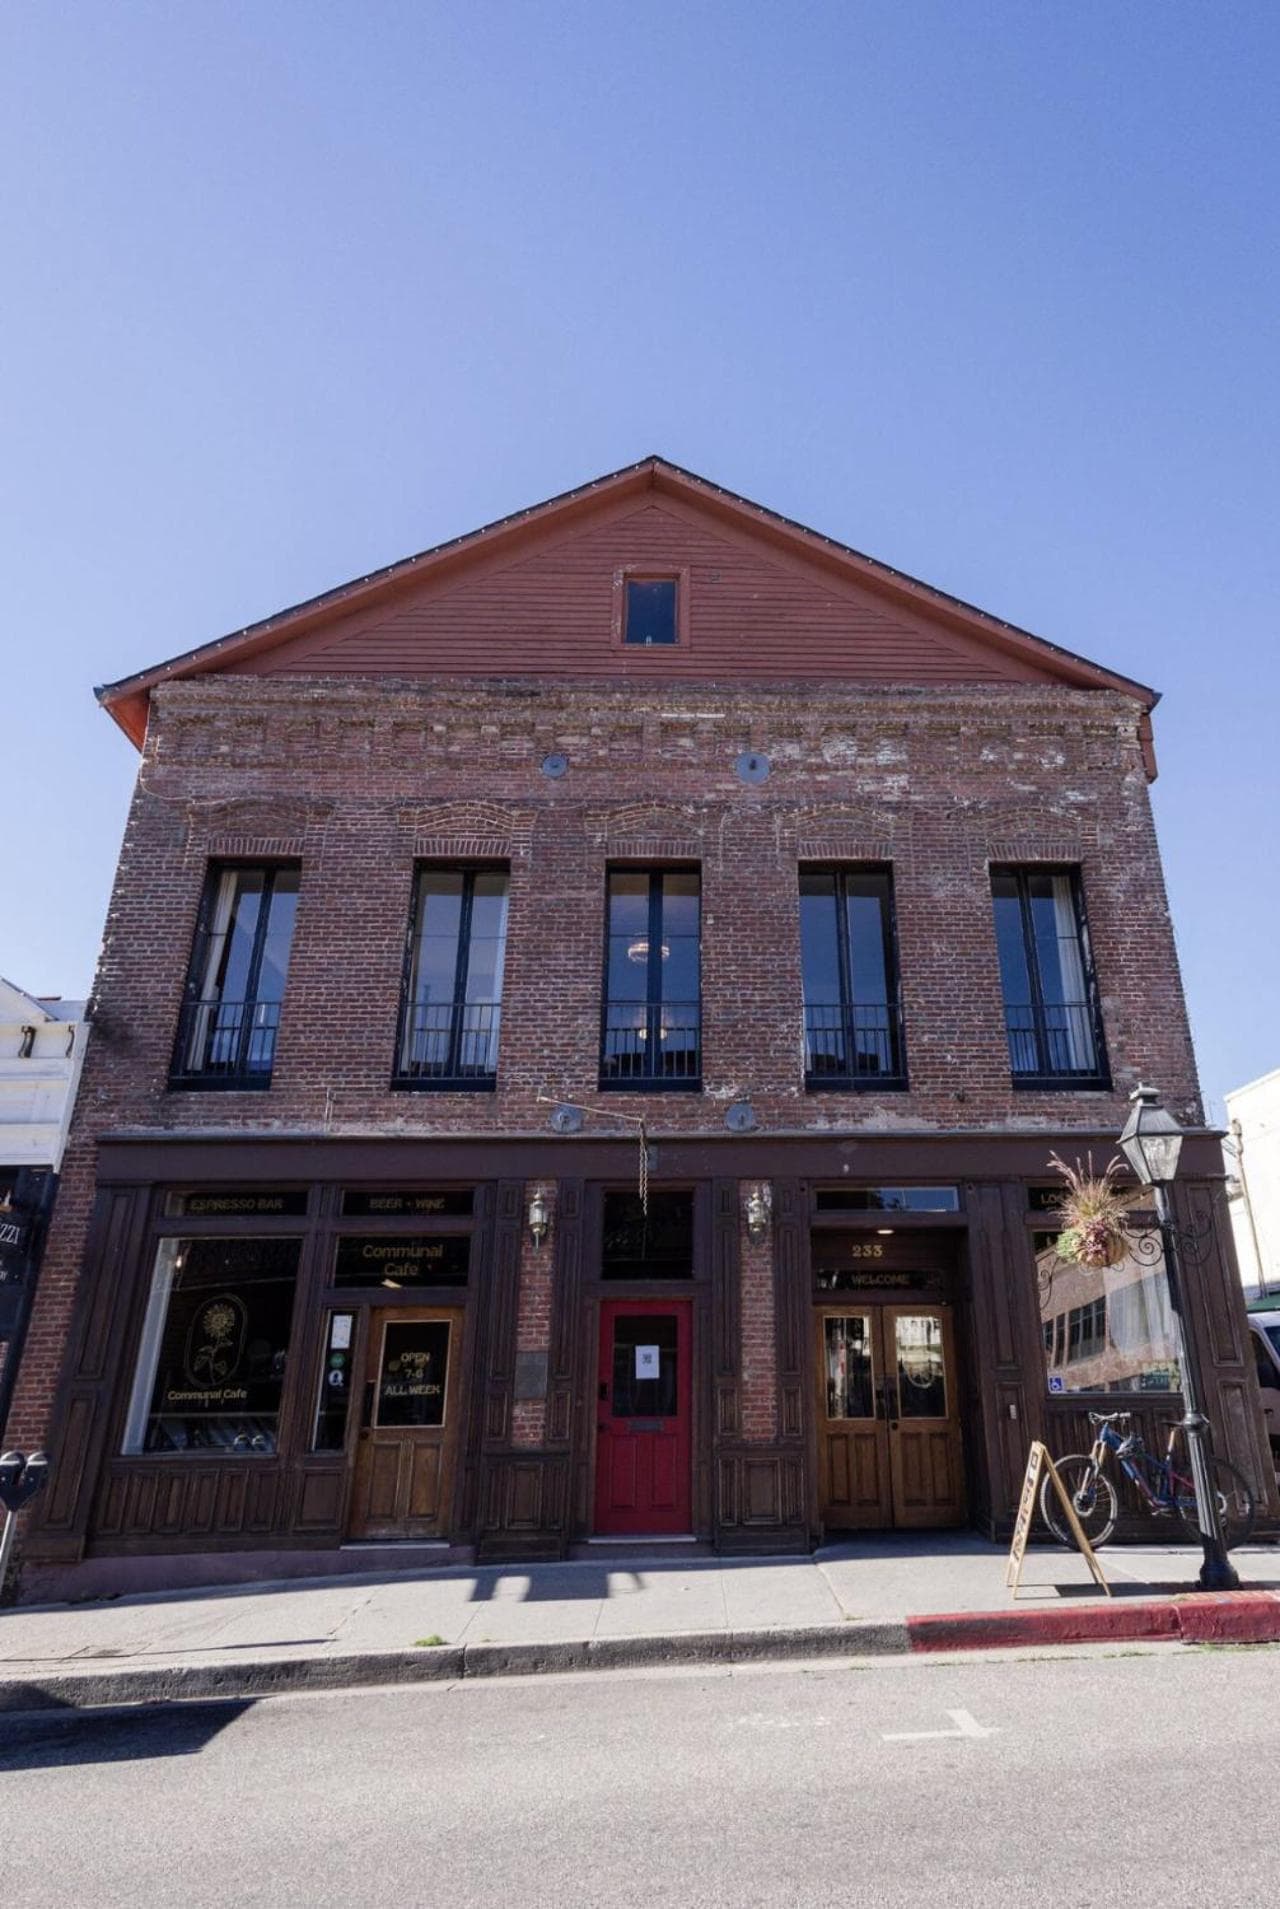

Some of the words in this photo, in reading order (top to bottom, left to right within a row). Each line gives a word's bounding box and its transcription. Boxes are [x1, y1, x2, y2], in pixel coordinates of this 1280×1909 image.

[190, 1198, 255, 1211] ESPRESSO
[257, 1198, 283, 1210] BAR
[369, 1198, 403, 1210] BEER
[415, 1198, 446, 1210] WINE
[362, 1242, 444, 1259] Communal
[852, 1244, 884, 1257] 233
[383, 1262, 419, 1277] Cafe
[851, 1273, 911, 1286] WELCOME
[400, 1352, 431, 1363] OPEN
[167, 1389, 222, 1401] Communal
[223, 1386, 248, 1399] Cafe
[384, 1385, 408, 1396] ALL
[408, 1384, 441, 1395] WEEK
